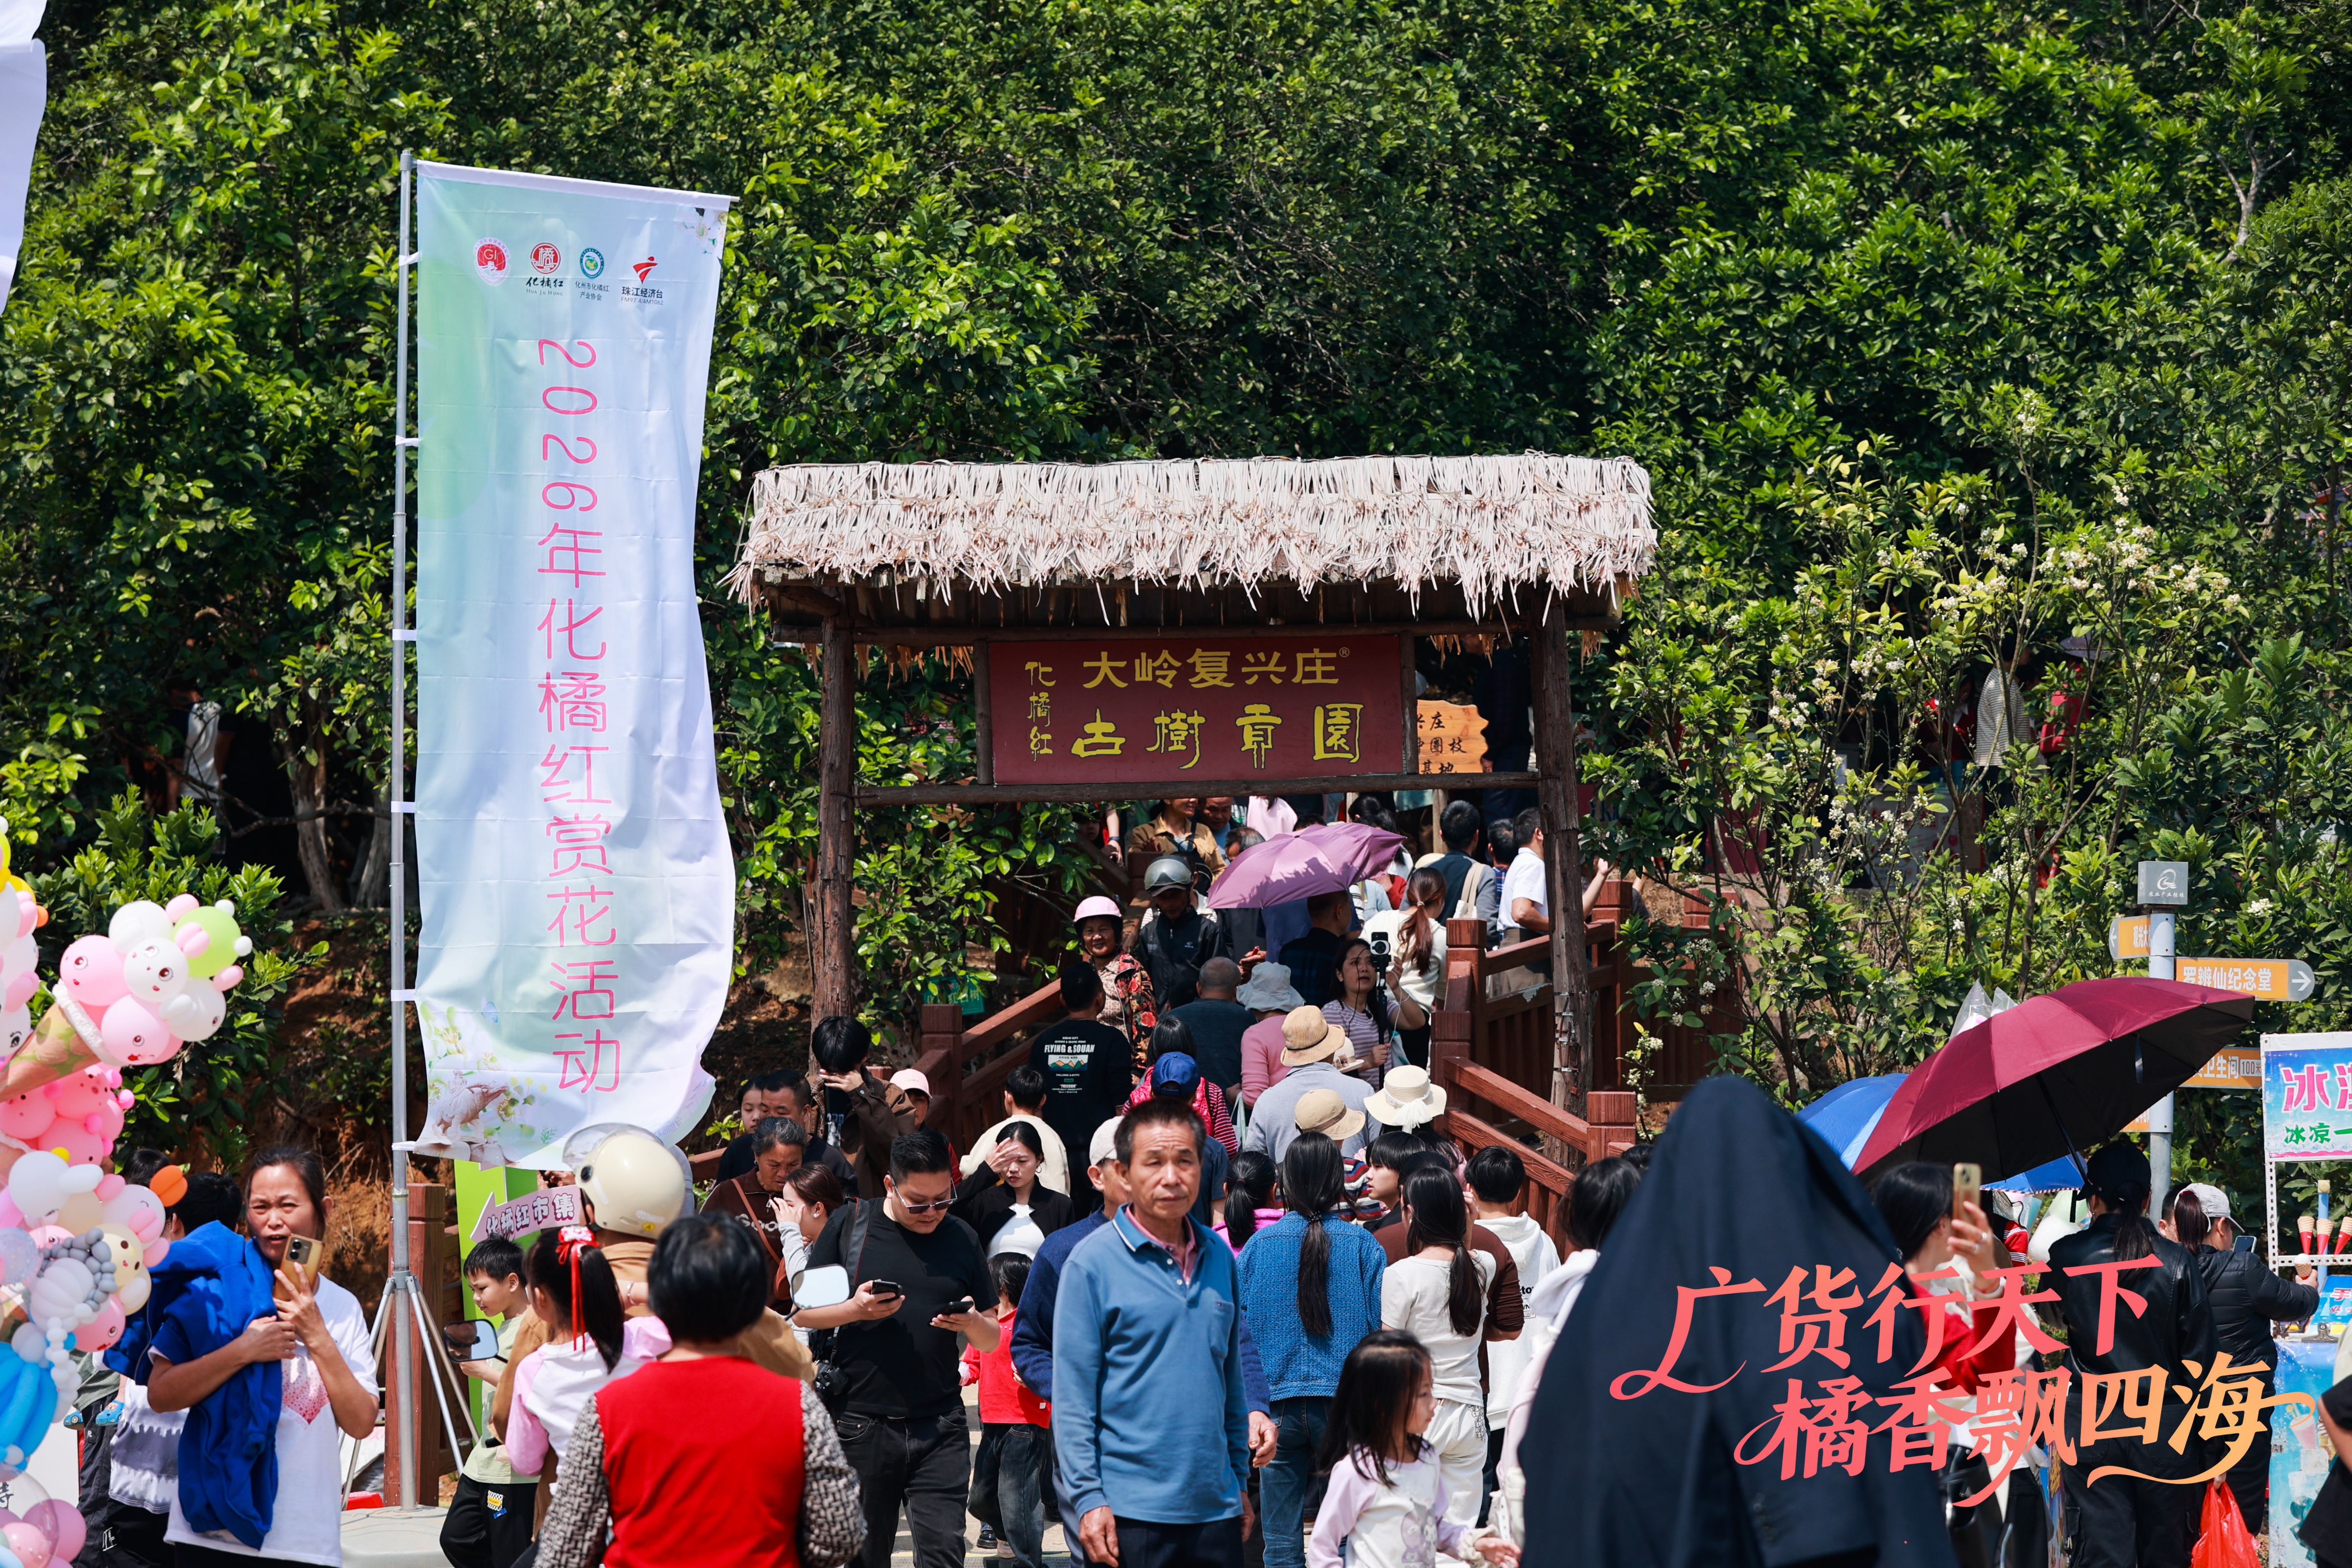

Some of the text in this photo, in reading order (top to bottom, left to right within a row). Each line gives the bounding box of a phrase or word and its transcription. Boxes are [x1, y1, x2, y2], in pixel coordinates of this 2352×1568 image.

[484, 249, 497, 260] GI
[526, 276, 564, 289] 化橘红
[575, 281, 610, 292] 化州市化橘红
[580, 292, 602, 301] 产业协会
[622, 286, 663, 299] 珠江经济台
[621, 296, 663, 305] FM97.4/AM1062
[538, 339, 621, 1094] 2026年化橘红赏花活动
[2133, 924, 2151, 948] 观光大
[1044, 1044, 1066, 1053] FLYING
[486, 1193, 575, 1237] 化橘红市集
